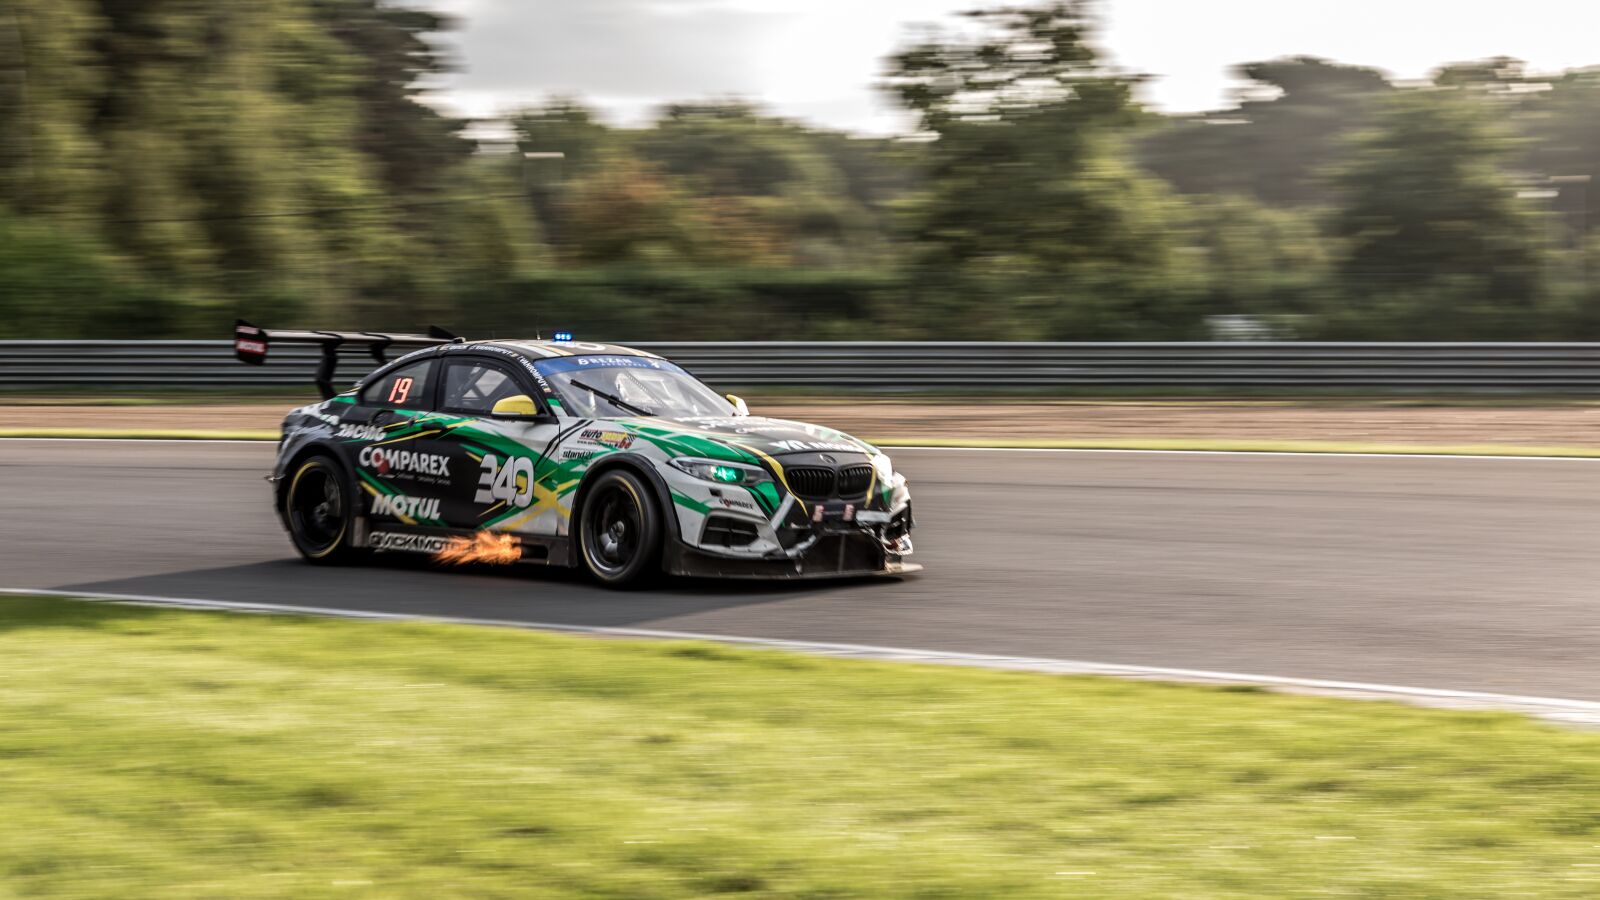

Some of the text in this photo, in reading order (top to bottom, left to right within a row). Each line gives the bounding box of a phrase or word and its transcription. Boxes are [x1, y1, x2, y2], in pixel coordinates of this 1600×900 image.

[388, 378, 413, 404] 19
[359, 446, 450, 477] COMPAREX
[474, 454, 535, 508] 340
[370, 494, 441, 521] MOTUL
